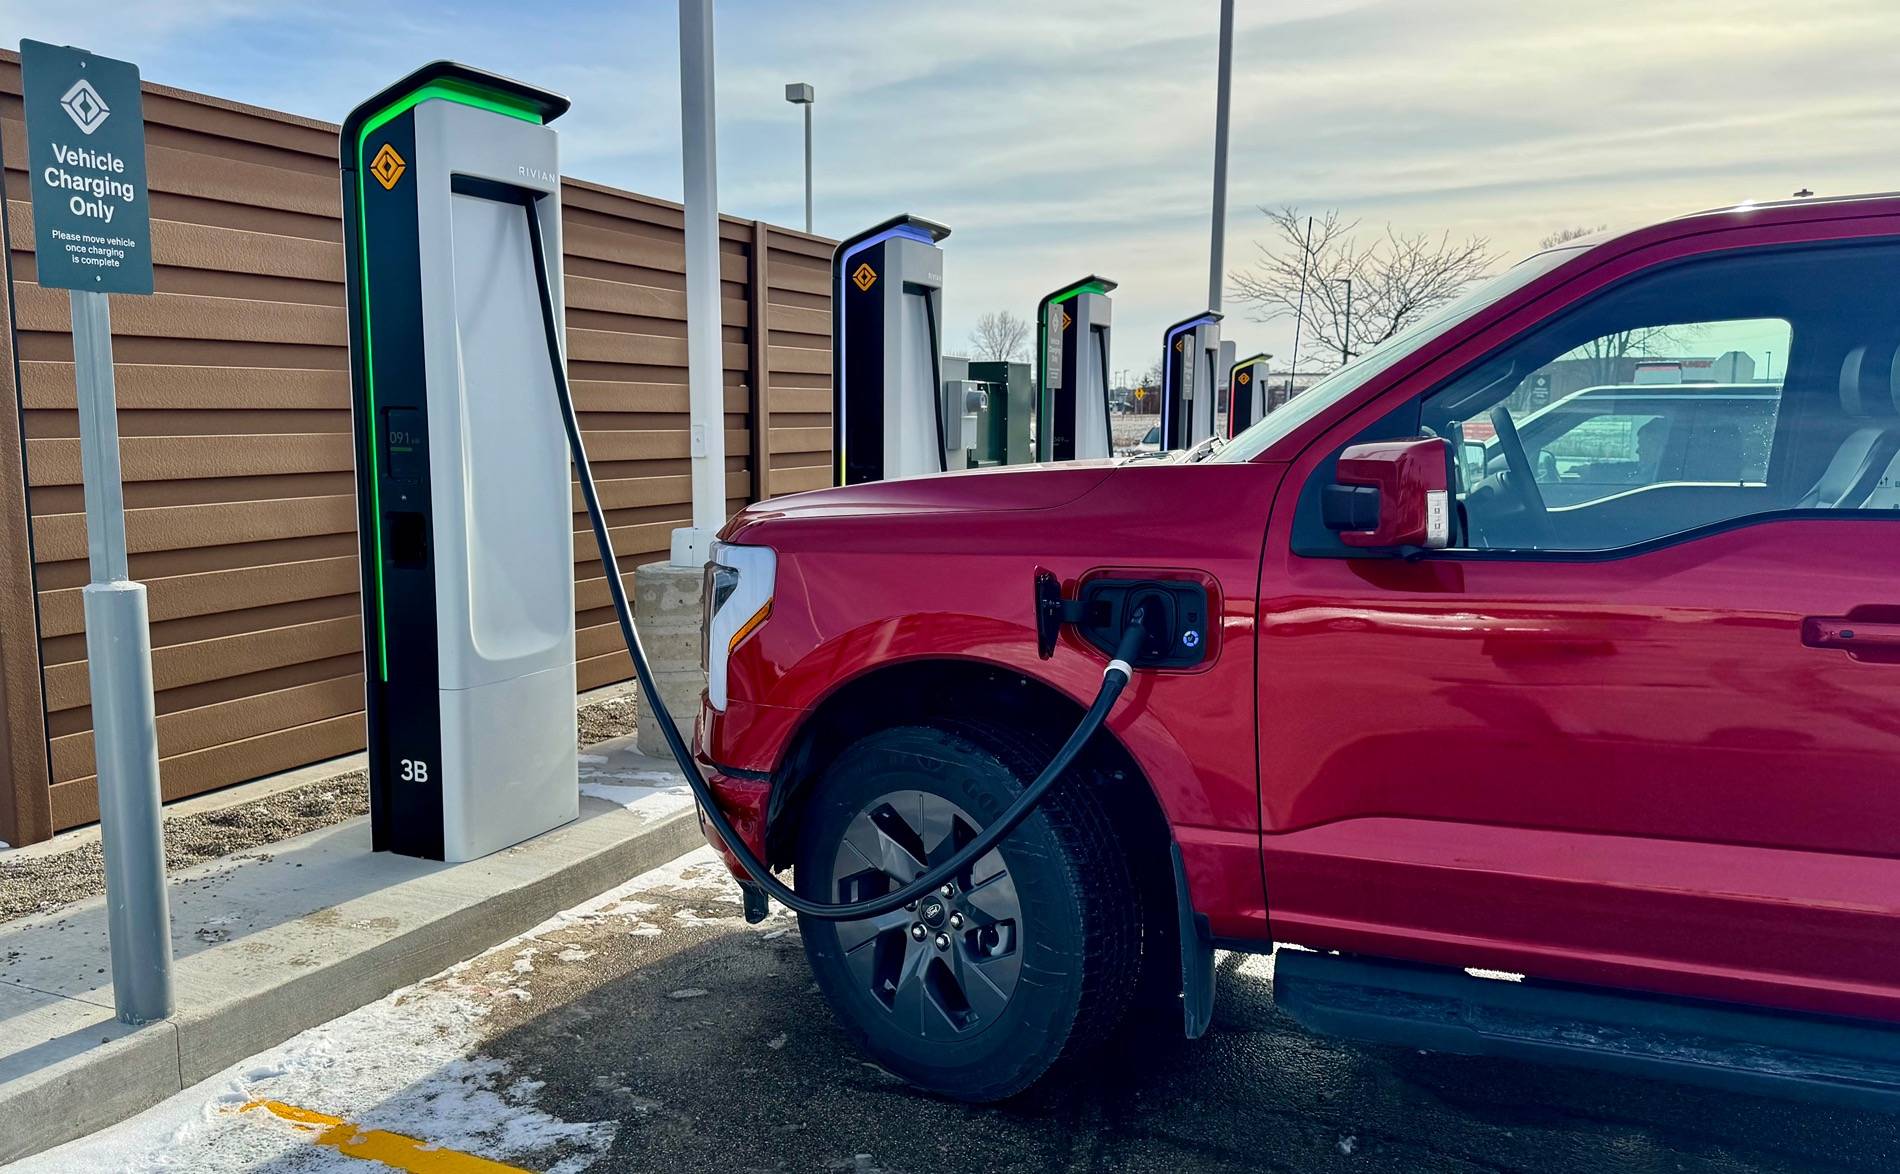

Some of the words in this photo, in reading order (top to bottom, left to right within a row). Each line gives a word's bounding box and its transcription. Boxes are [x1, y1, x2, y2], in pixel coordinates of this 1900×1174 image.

[51, 143, 125, 173] Vehicle
[44, 167, 134, 202] Charging
[518, 166, 555, 183] RIVIAN
[69, 196, 114, 223] Only
[52, 229, 81, 241] Please
[82, 235, 105, 244] move
[106, 237, 136, 248] vehicle
[65, 244, 87, 253] once
[87, 245, 124, 258] charging
[71, 254, 80, 263] is
[80, 256, 120, 267] complete
[400, 758, 428, 783] 3B
